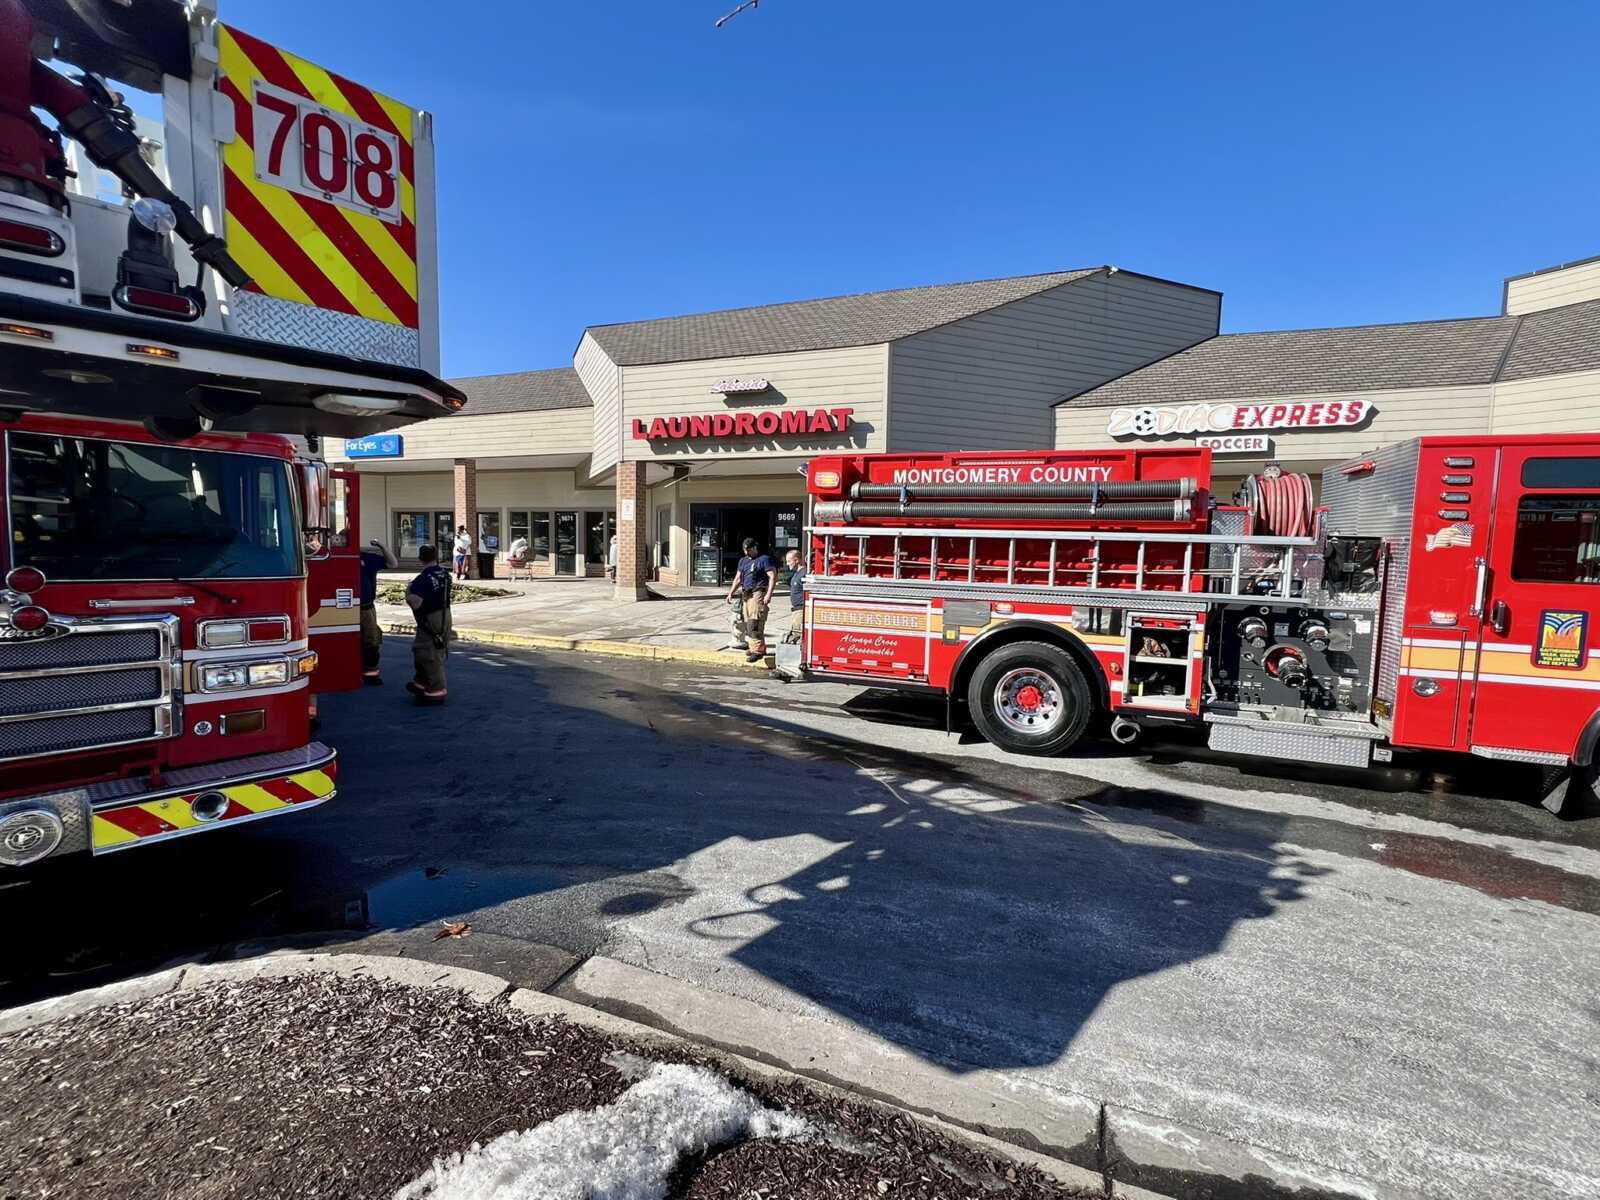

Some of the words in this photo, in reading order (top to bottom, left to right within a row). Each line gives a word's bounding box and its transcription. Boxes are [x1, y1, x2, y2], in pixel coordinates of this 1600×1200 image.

[255, 89, 396, 210] 708
[632, 407, 854, 441] LAUNDROMAT
[1231, 400, 1366, 430] EXPRESS
[1199, 437, 1264, 450] SOCCER
[893, 467, 1022, 484] MONTGOMERY
[1029, 466, 1113, 483] COUNTY
[777, 513, 796, 521] 9669
[820, 610, 919, 628] GAITHERSBURG
[840, 633, 873, 646] Always
[874, 635, 898, 647] Cross
[847, 643, 895, 657] Crosswalks
